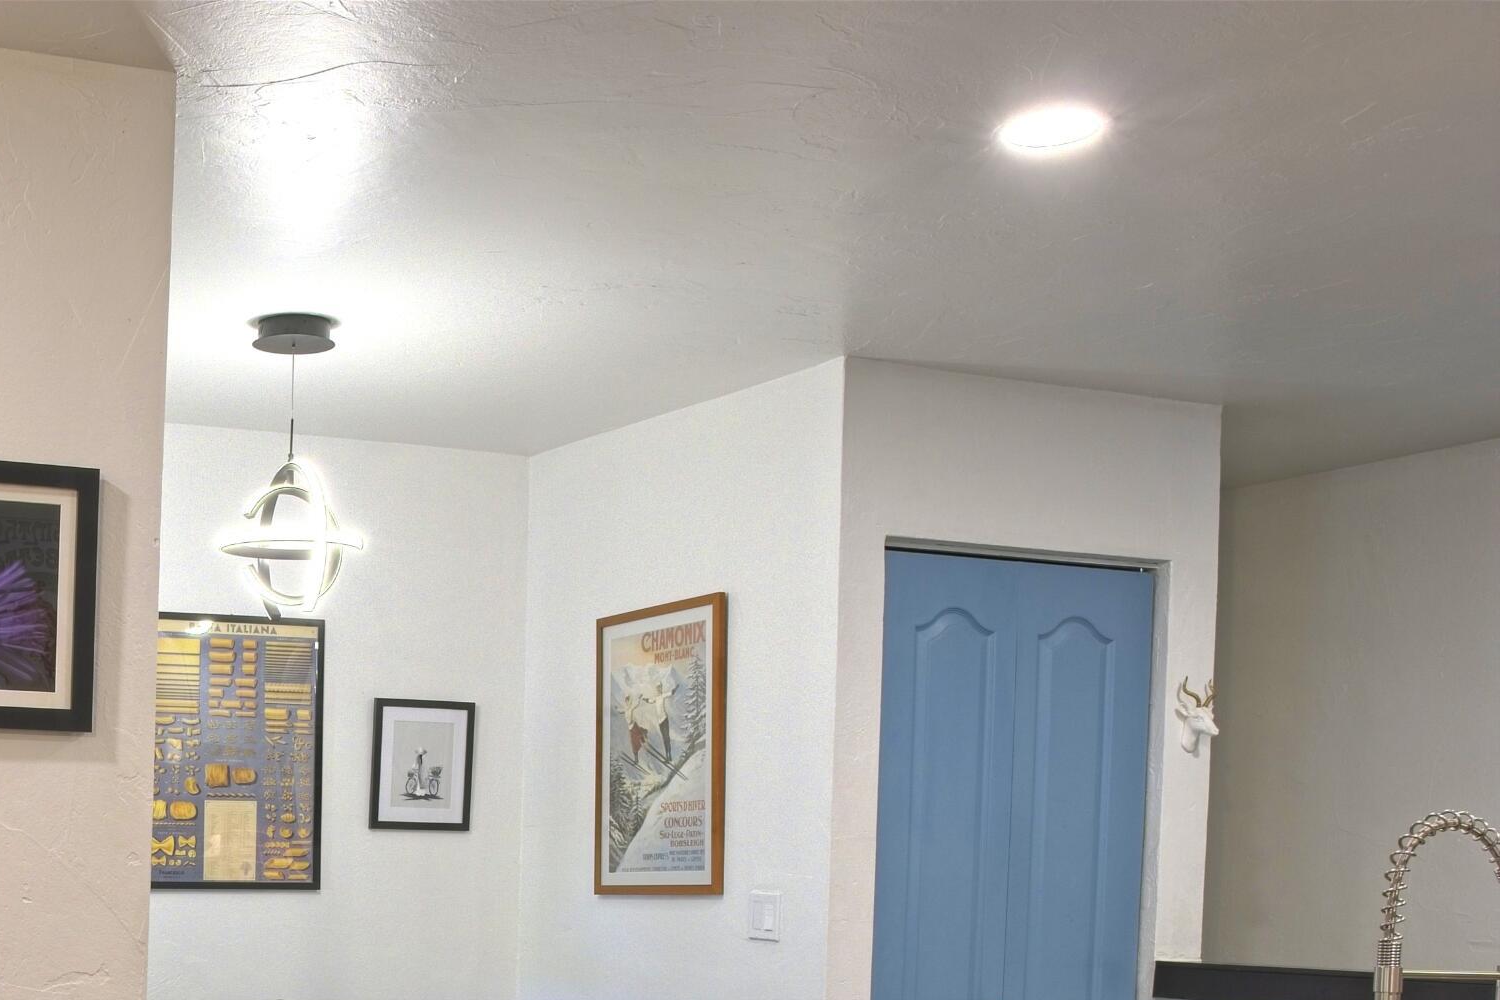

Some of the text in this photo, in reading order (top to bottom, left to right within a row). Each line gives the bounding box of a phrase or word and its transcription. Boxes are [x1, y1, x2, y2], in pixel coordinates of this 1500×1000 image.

[227, 623, 277, 635] ITALIANA
[641, 621, 706, 653] CHAMONIX
[664, 816, 703, 829] CONCOURS
